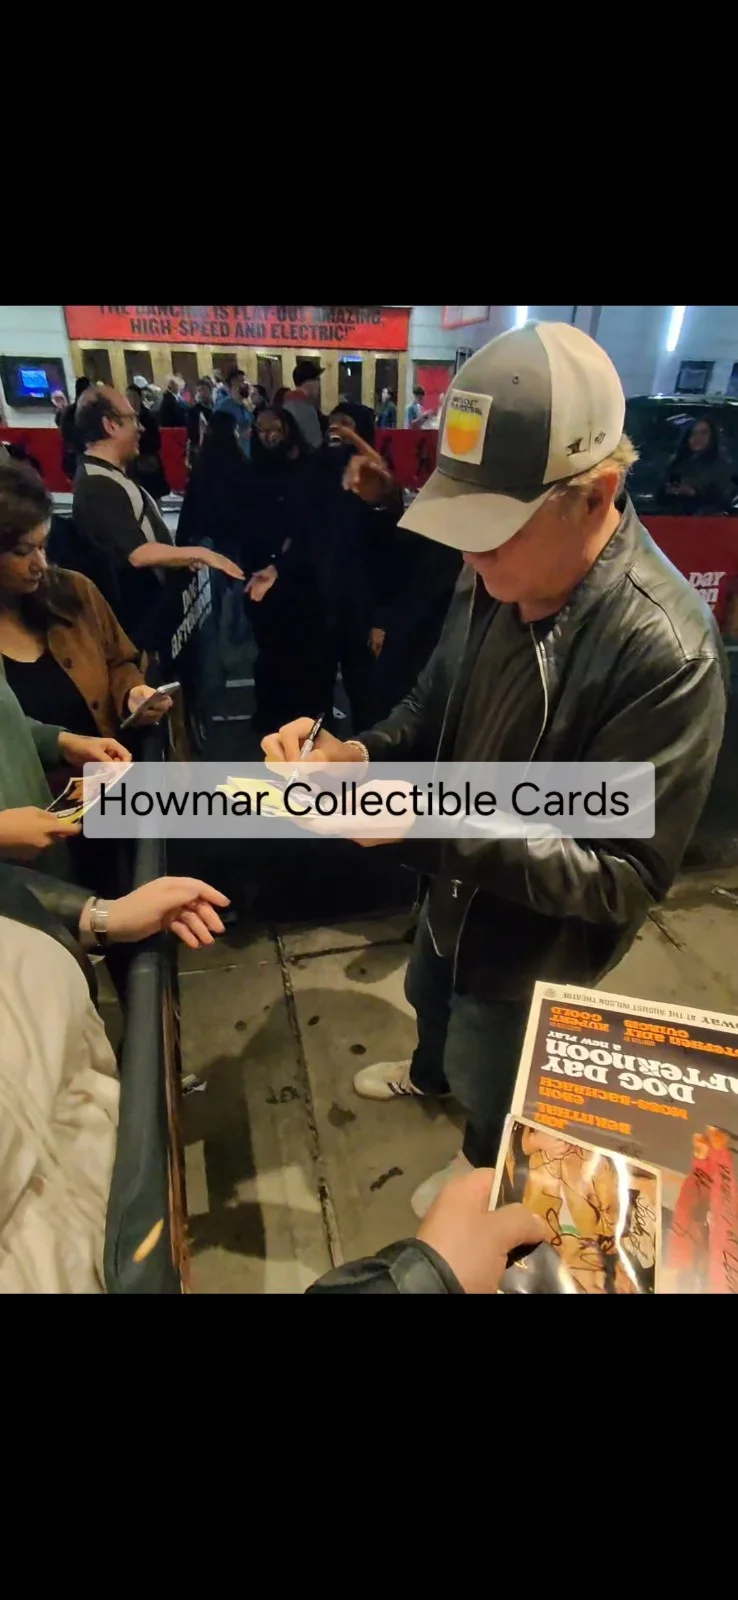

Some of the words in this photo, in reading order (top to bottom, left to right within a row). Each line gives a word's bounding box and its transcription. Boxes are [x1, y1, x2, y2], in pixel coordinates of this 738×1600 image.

[214, 305, 229, 320] IS
[130, 318, 230, 337] HIGH-SPEED
[235, 322, 266, 338] AND
[563, 991, 596, 1004] THEATRE
[668, 1010, 683, 1019] THE
[617, 1072, 696, 1104] DOG
